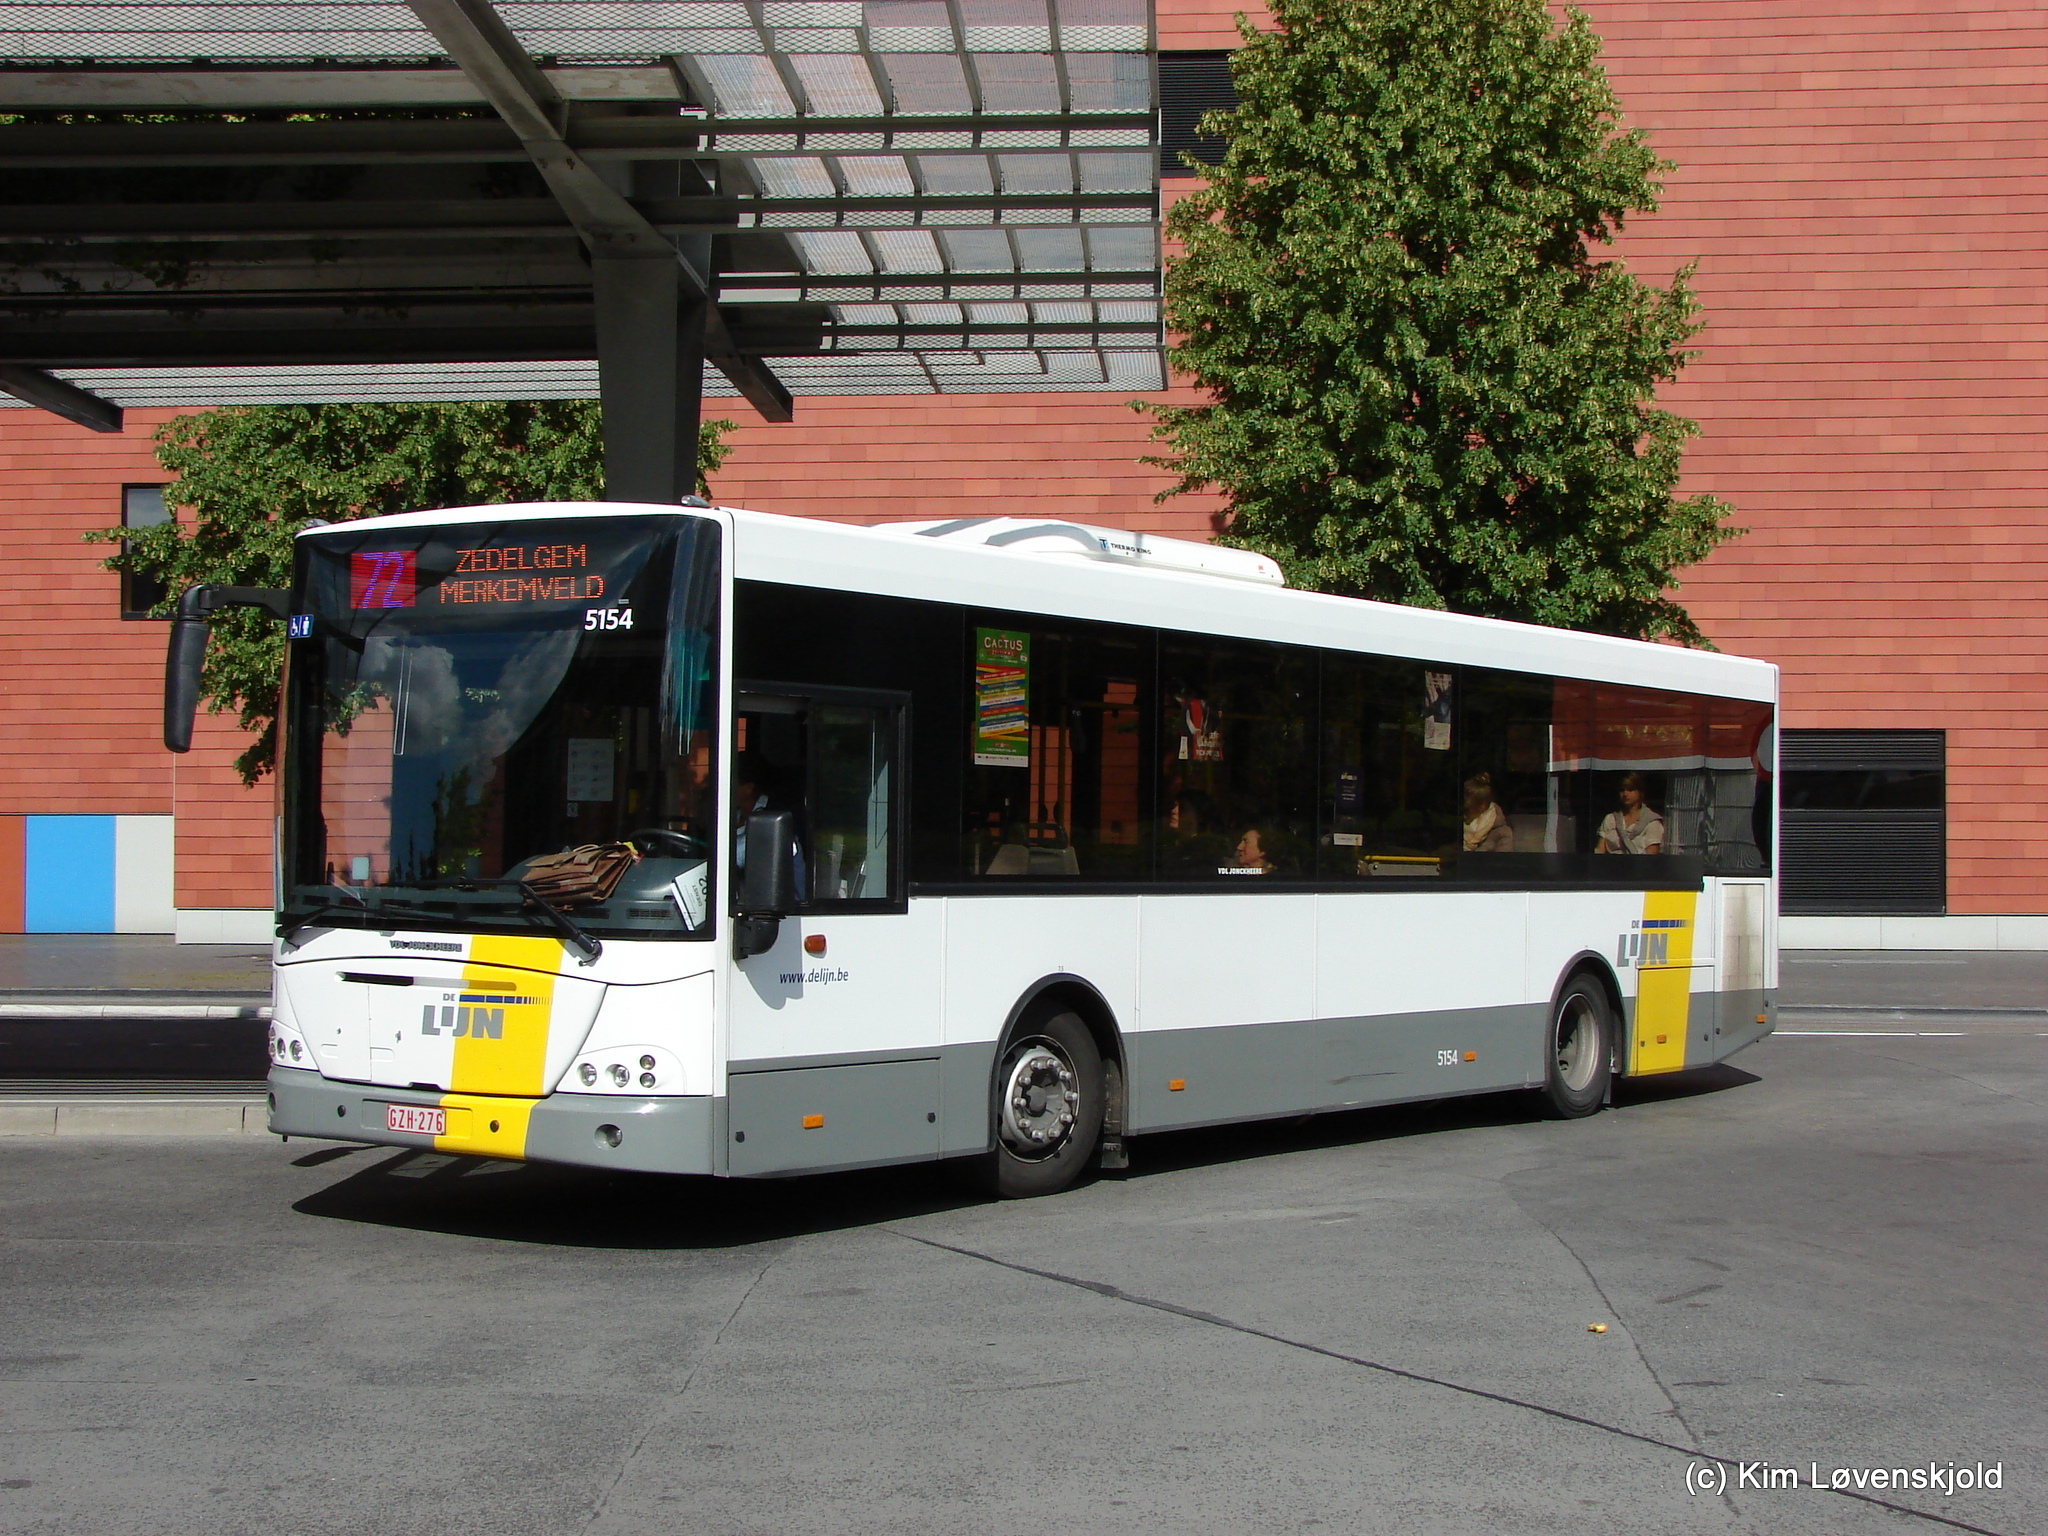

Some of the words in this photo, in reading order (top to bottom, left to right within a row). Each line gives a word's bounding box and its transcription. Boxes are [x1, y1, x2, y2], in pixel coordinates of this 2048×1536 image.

[455, 544, 587, 573] ZEDELGEM
[1110, 542, 1135, 552] THERMO
[1136, 547, 1152, 555] KING
[360, 551, 404, 609] 72
[439, 574, 605, 604] MERKEMVELD
[584, 608, 634, 631] 5154
[984, 636, 1023, 651] CACTUS
[1631, 920, 1640, 929] DE
[1617, 933, 1668, 968] LIJN
[780, 967, 849, 985] www.delijn.be
[442, 993, 456, 1001] DE
[422, 1005, 504, 1039] LIJN
[1437, 1050, 1458, 1066] 5154
